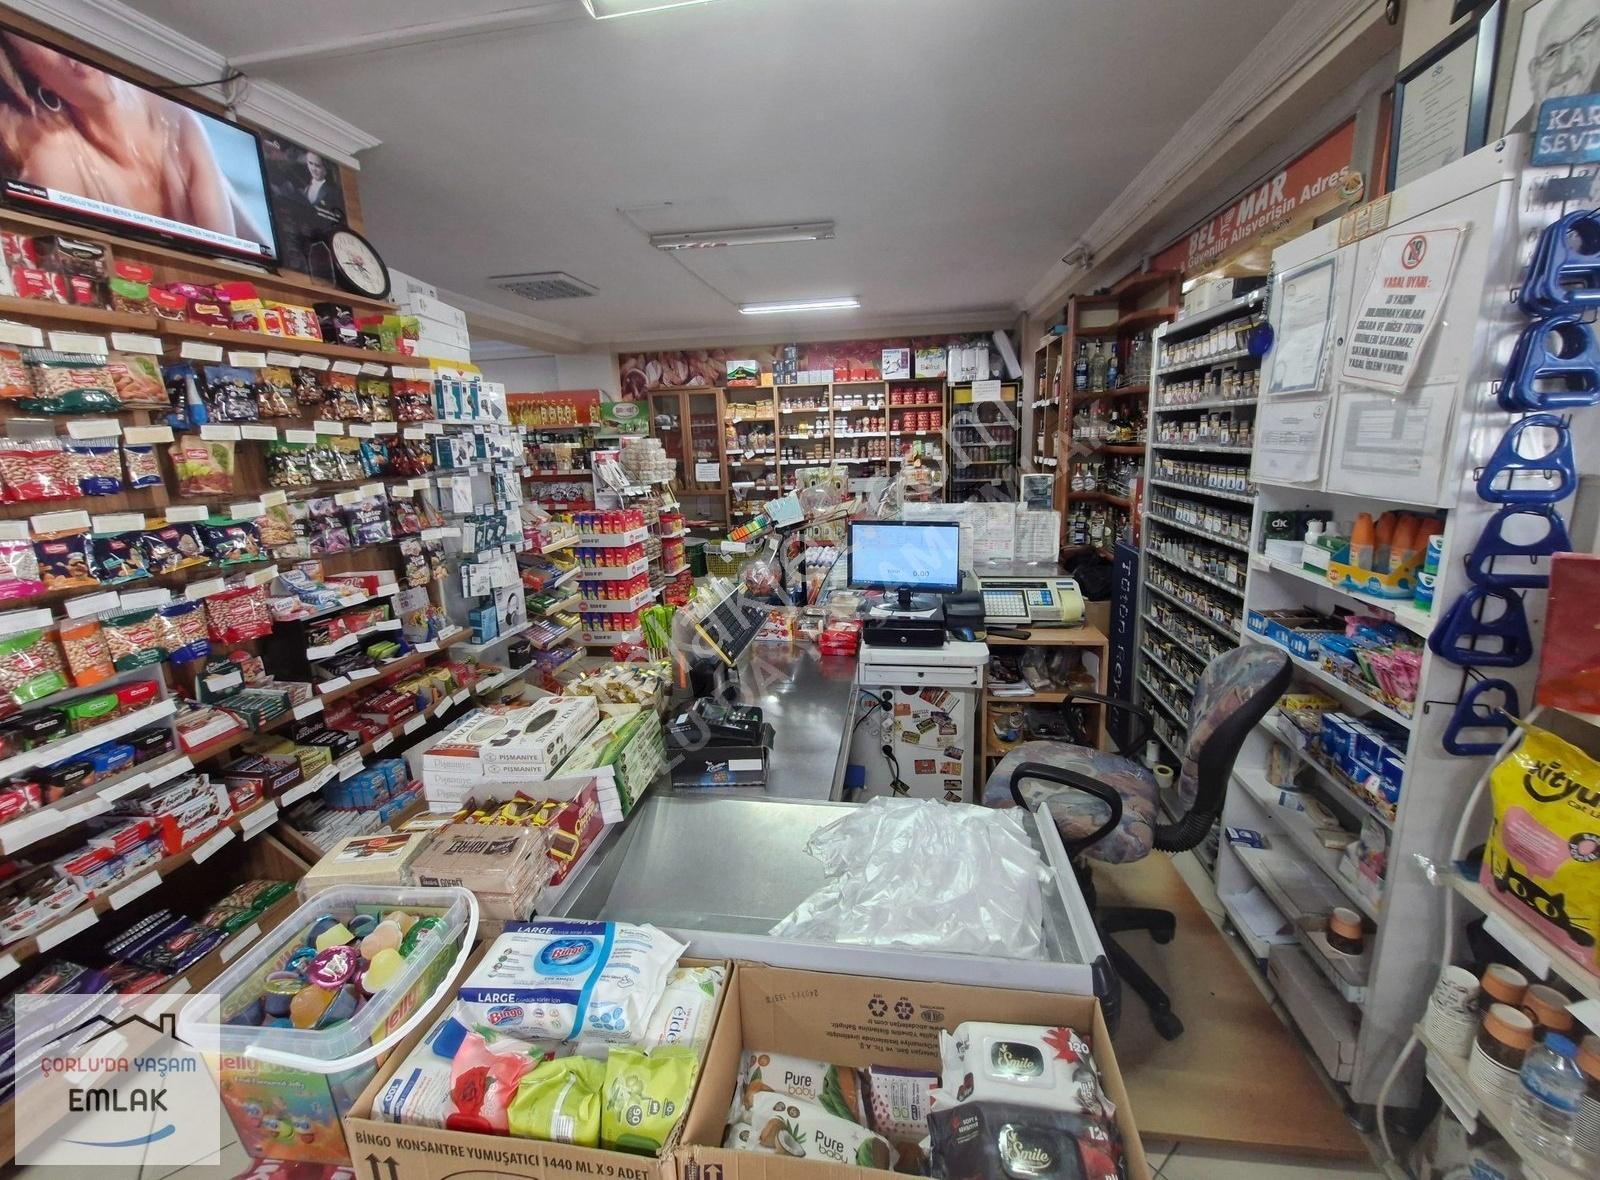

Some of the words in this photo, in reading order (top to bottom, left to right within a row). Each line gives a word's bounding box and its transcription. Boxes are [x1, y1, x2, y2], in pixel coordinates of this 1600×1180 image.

[1237, 170, 1288, 227] MAR
[1383, 276, 1405, 288] YASAL
[517, 926, 554, 935] LARGE
[551, 944, 586, 961] Bingo
[477, 992, 515, 1003] LARGE
[487, 1005, 524, 1026] Bingo
[1068, 1041, 1089, 1054] 120
[999, 1050, 1036, 1070] Smile
[784, 1070, 812, 1086] Pure
[788, 1084, 816, 1100] baby
[815, 1129, 844, 1153] Pure
[355, 1131, 392, 1148] BİNGO
[396, 1137, 465, 1159] KONSANTRE
[465, 1143, 540, 1167] YUMUŞATICI
[542, 1155, 573, 1171] 1440
[576, 1159, 595, 1173] ML
[596, 1161, 605, 1174] X
[606, 1163, 616, 1176] 9
[617, 1164, 650, 1180] ADET
[1009, 1141, 1050, 1162] Smile
